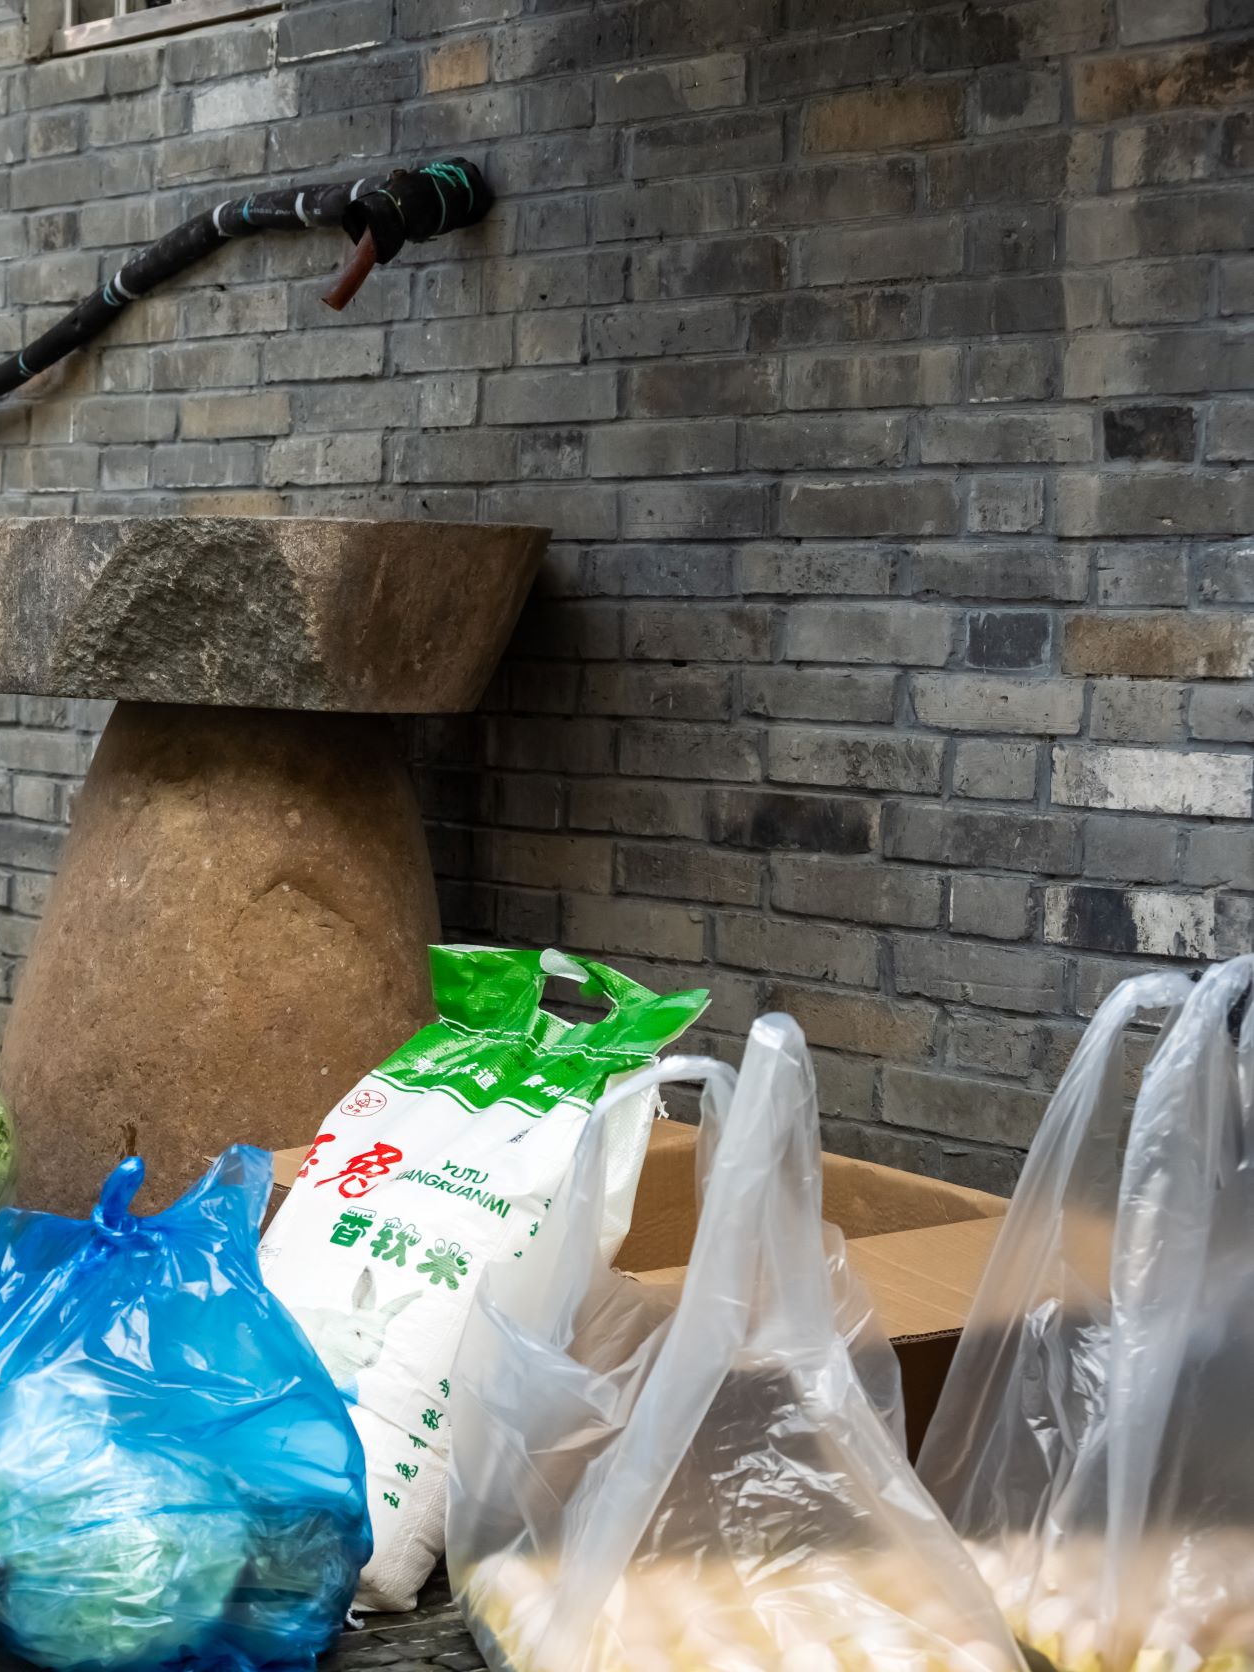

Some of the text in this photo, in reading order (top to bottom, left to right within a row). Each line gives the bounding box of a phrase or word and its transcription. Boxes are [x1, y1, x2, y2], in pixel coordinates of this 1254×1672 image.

[442, 1159, 490, 1185] YUTU
[329, 1205, 474, 1291] 香软米
